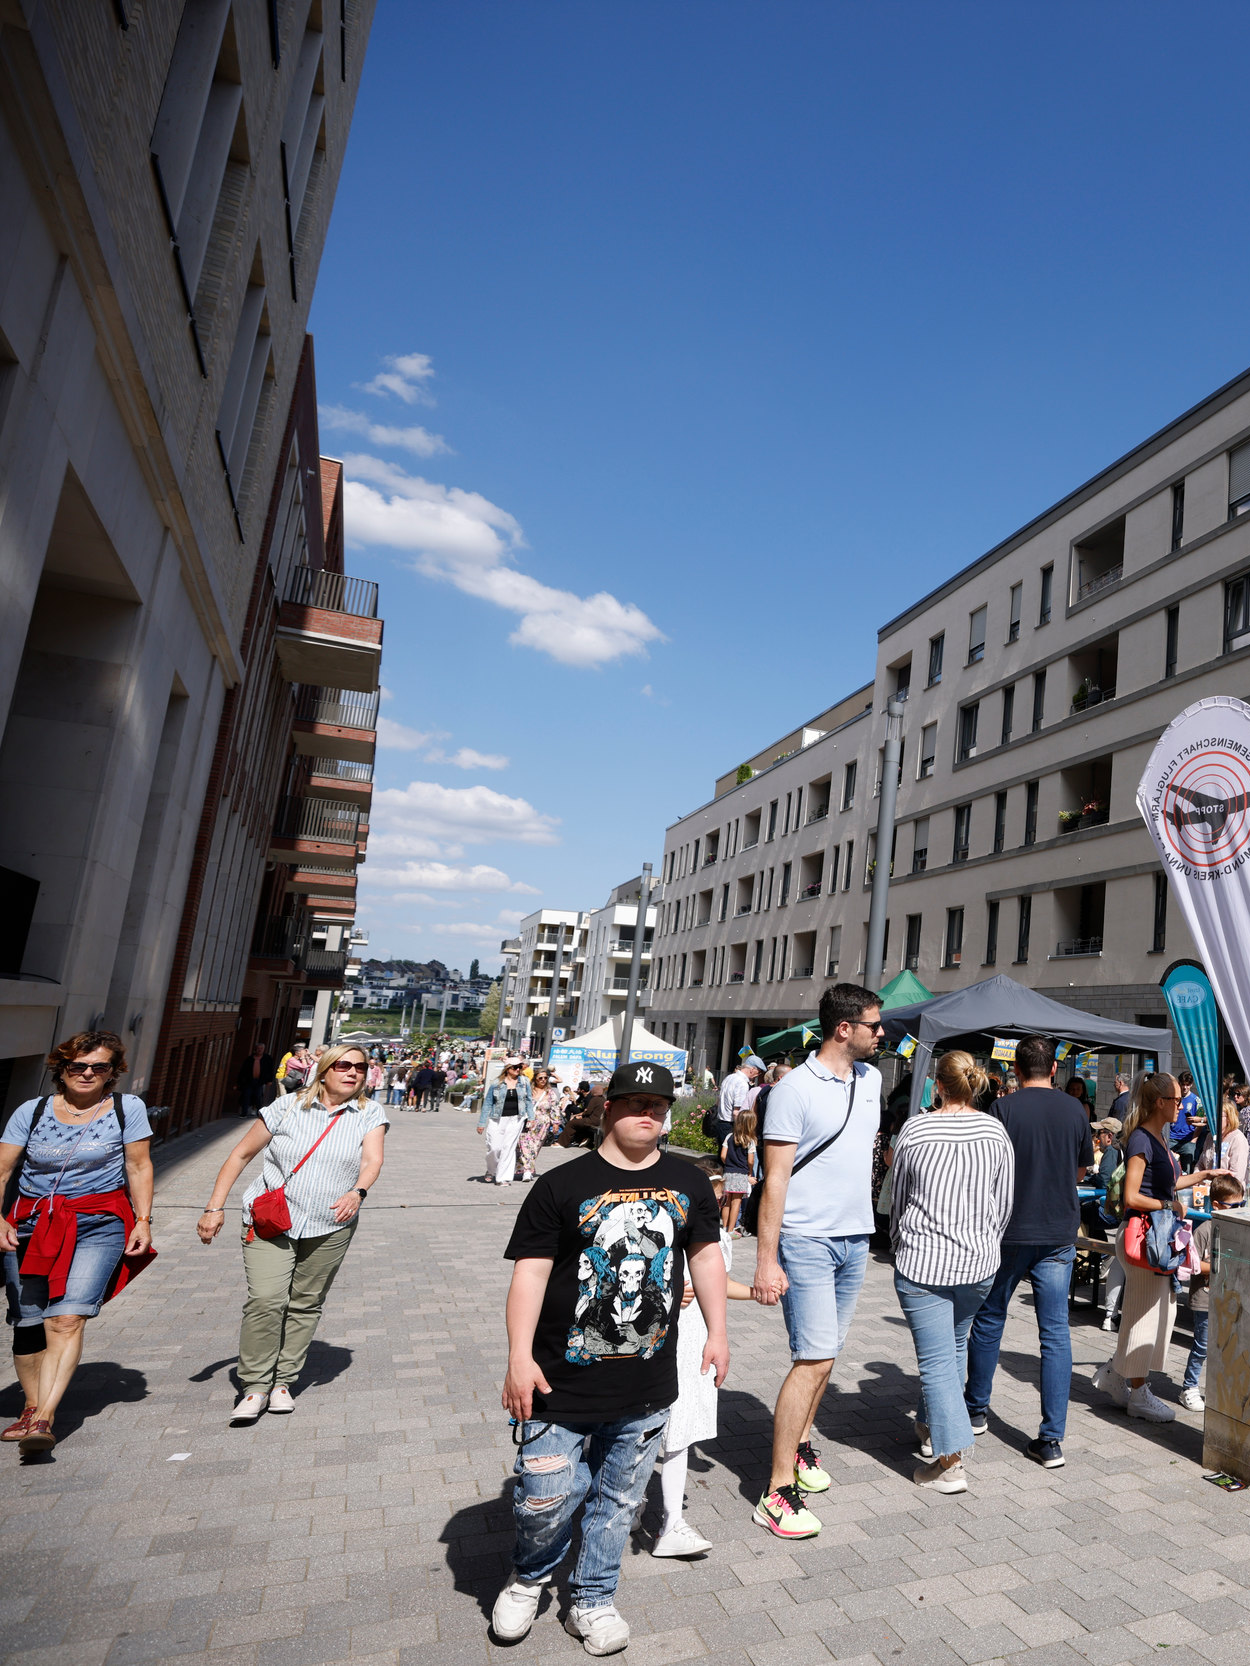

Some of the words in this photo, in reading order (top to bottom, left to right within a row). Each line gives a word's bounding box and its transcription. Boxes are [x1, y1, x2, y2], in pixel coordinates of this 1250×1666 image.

[631, 1051, 675, 1062] Gong
[635, 1066, 654, 1084] NY
[577, 1187, 687, 1228] METALLICA
